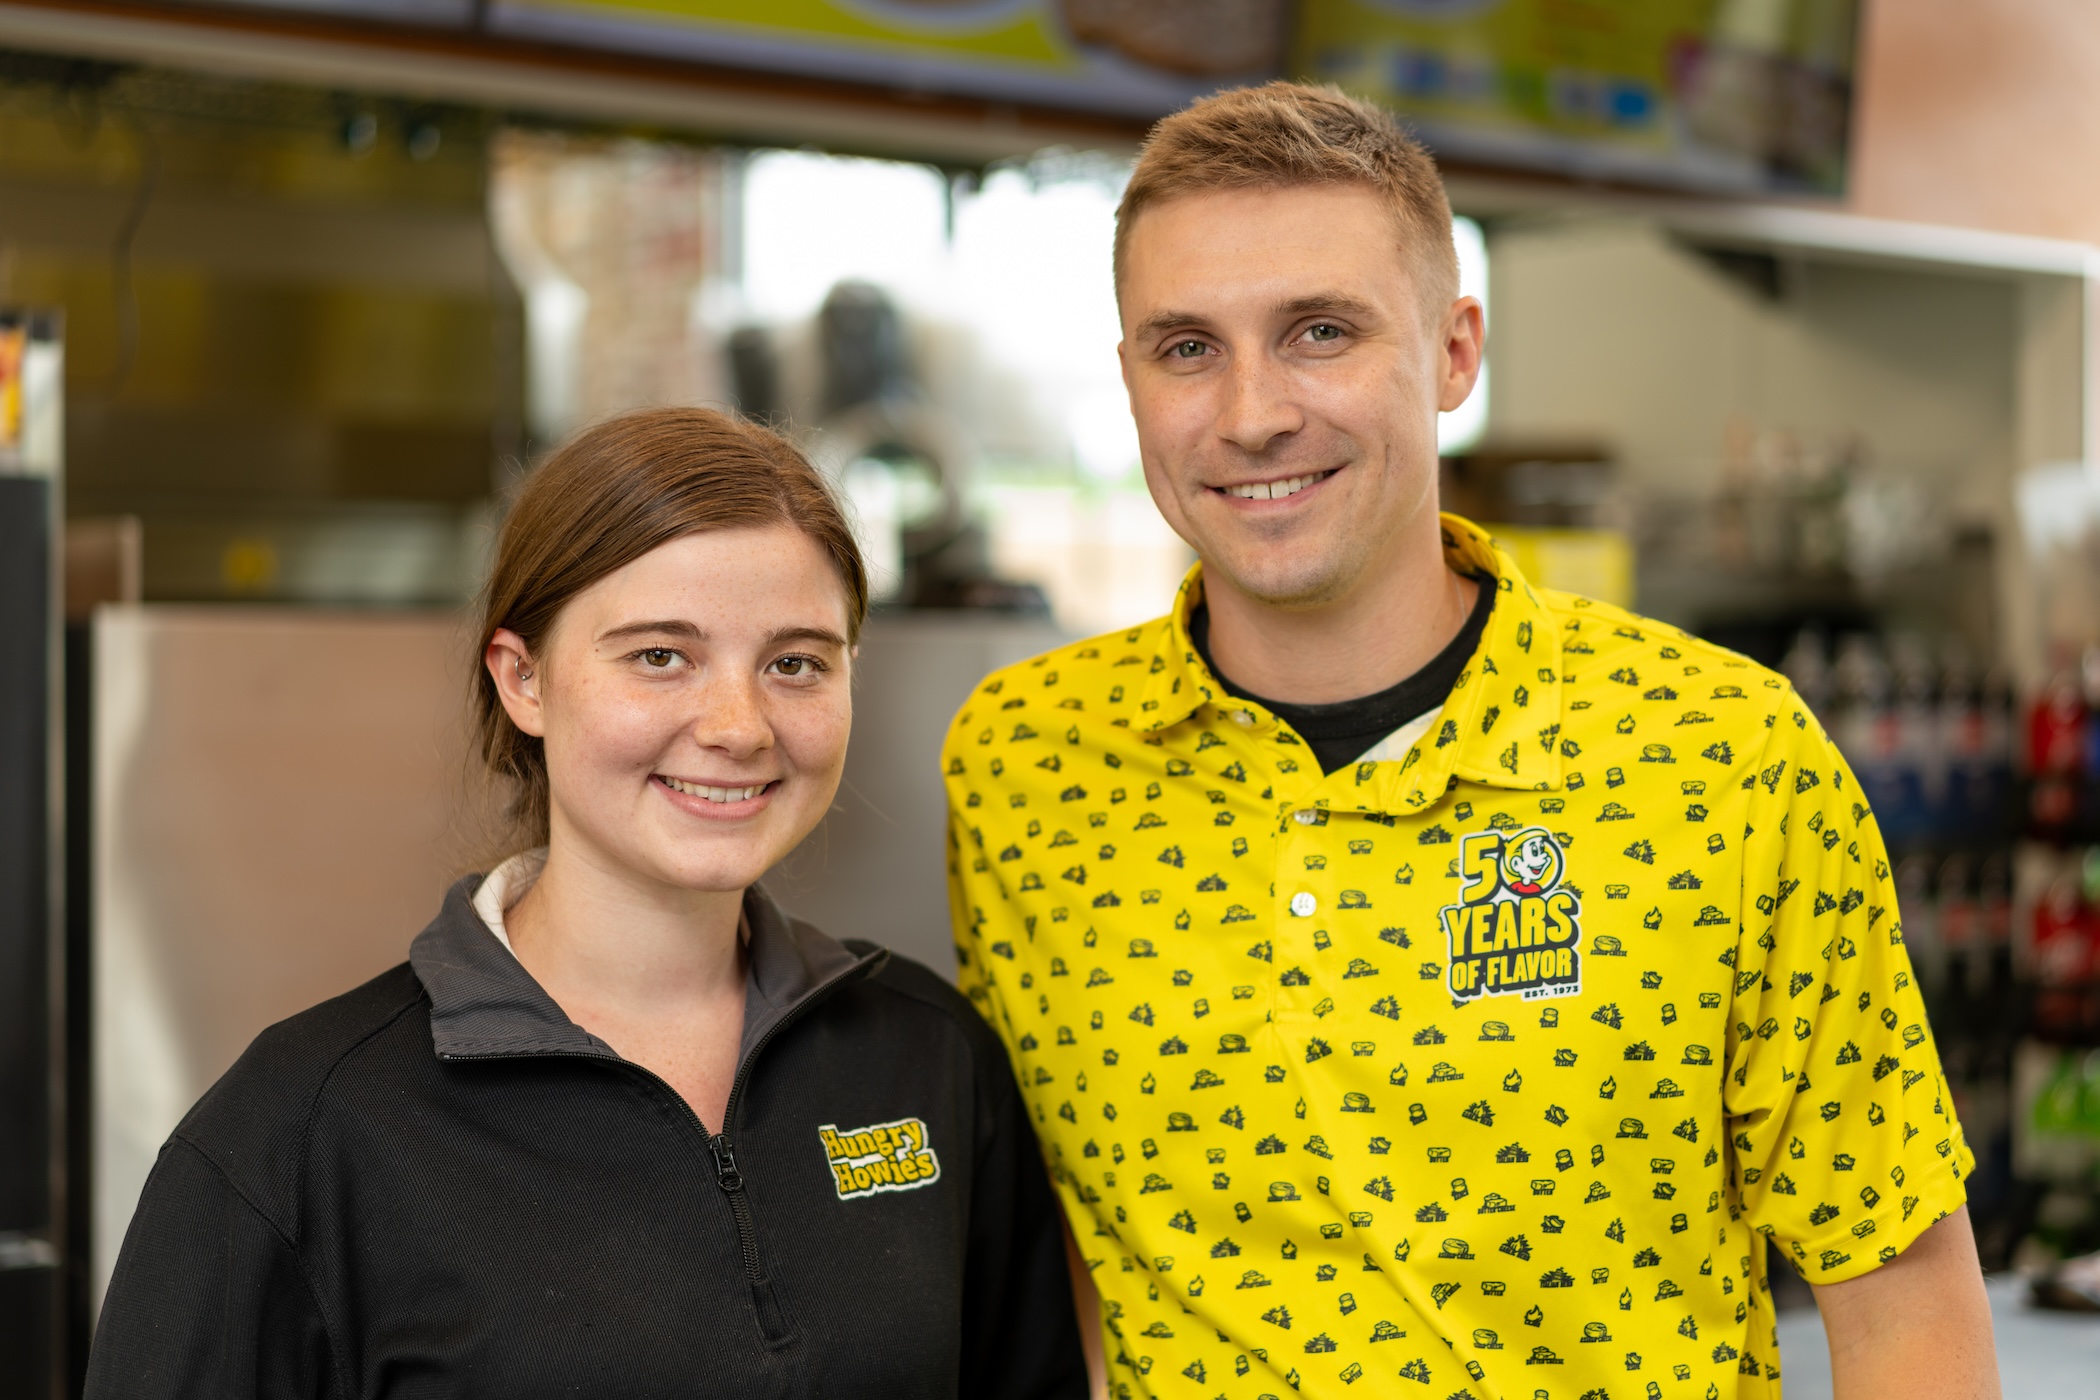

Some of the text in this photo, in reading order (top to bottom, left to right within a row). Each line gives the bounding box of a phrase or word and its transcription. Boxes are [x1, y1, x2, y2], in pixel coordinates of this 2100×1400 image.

[1445, 893, 1579, 958] YEARS
[1451, 947, 1575, 993] OF FLAVOR
[1524, 985, 1579, 999] EST. 1973
[820, 1120, 923, 1159] Hungry
[832, 1151, 935, 1194] Howie's
